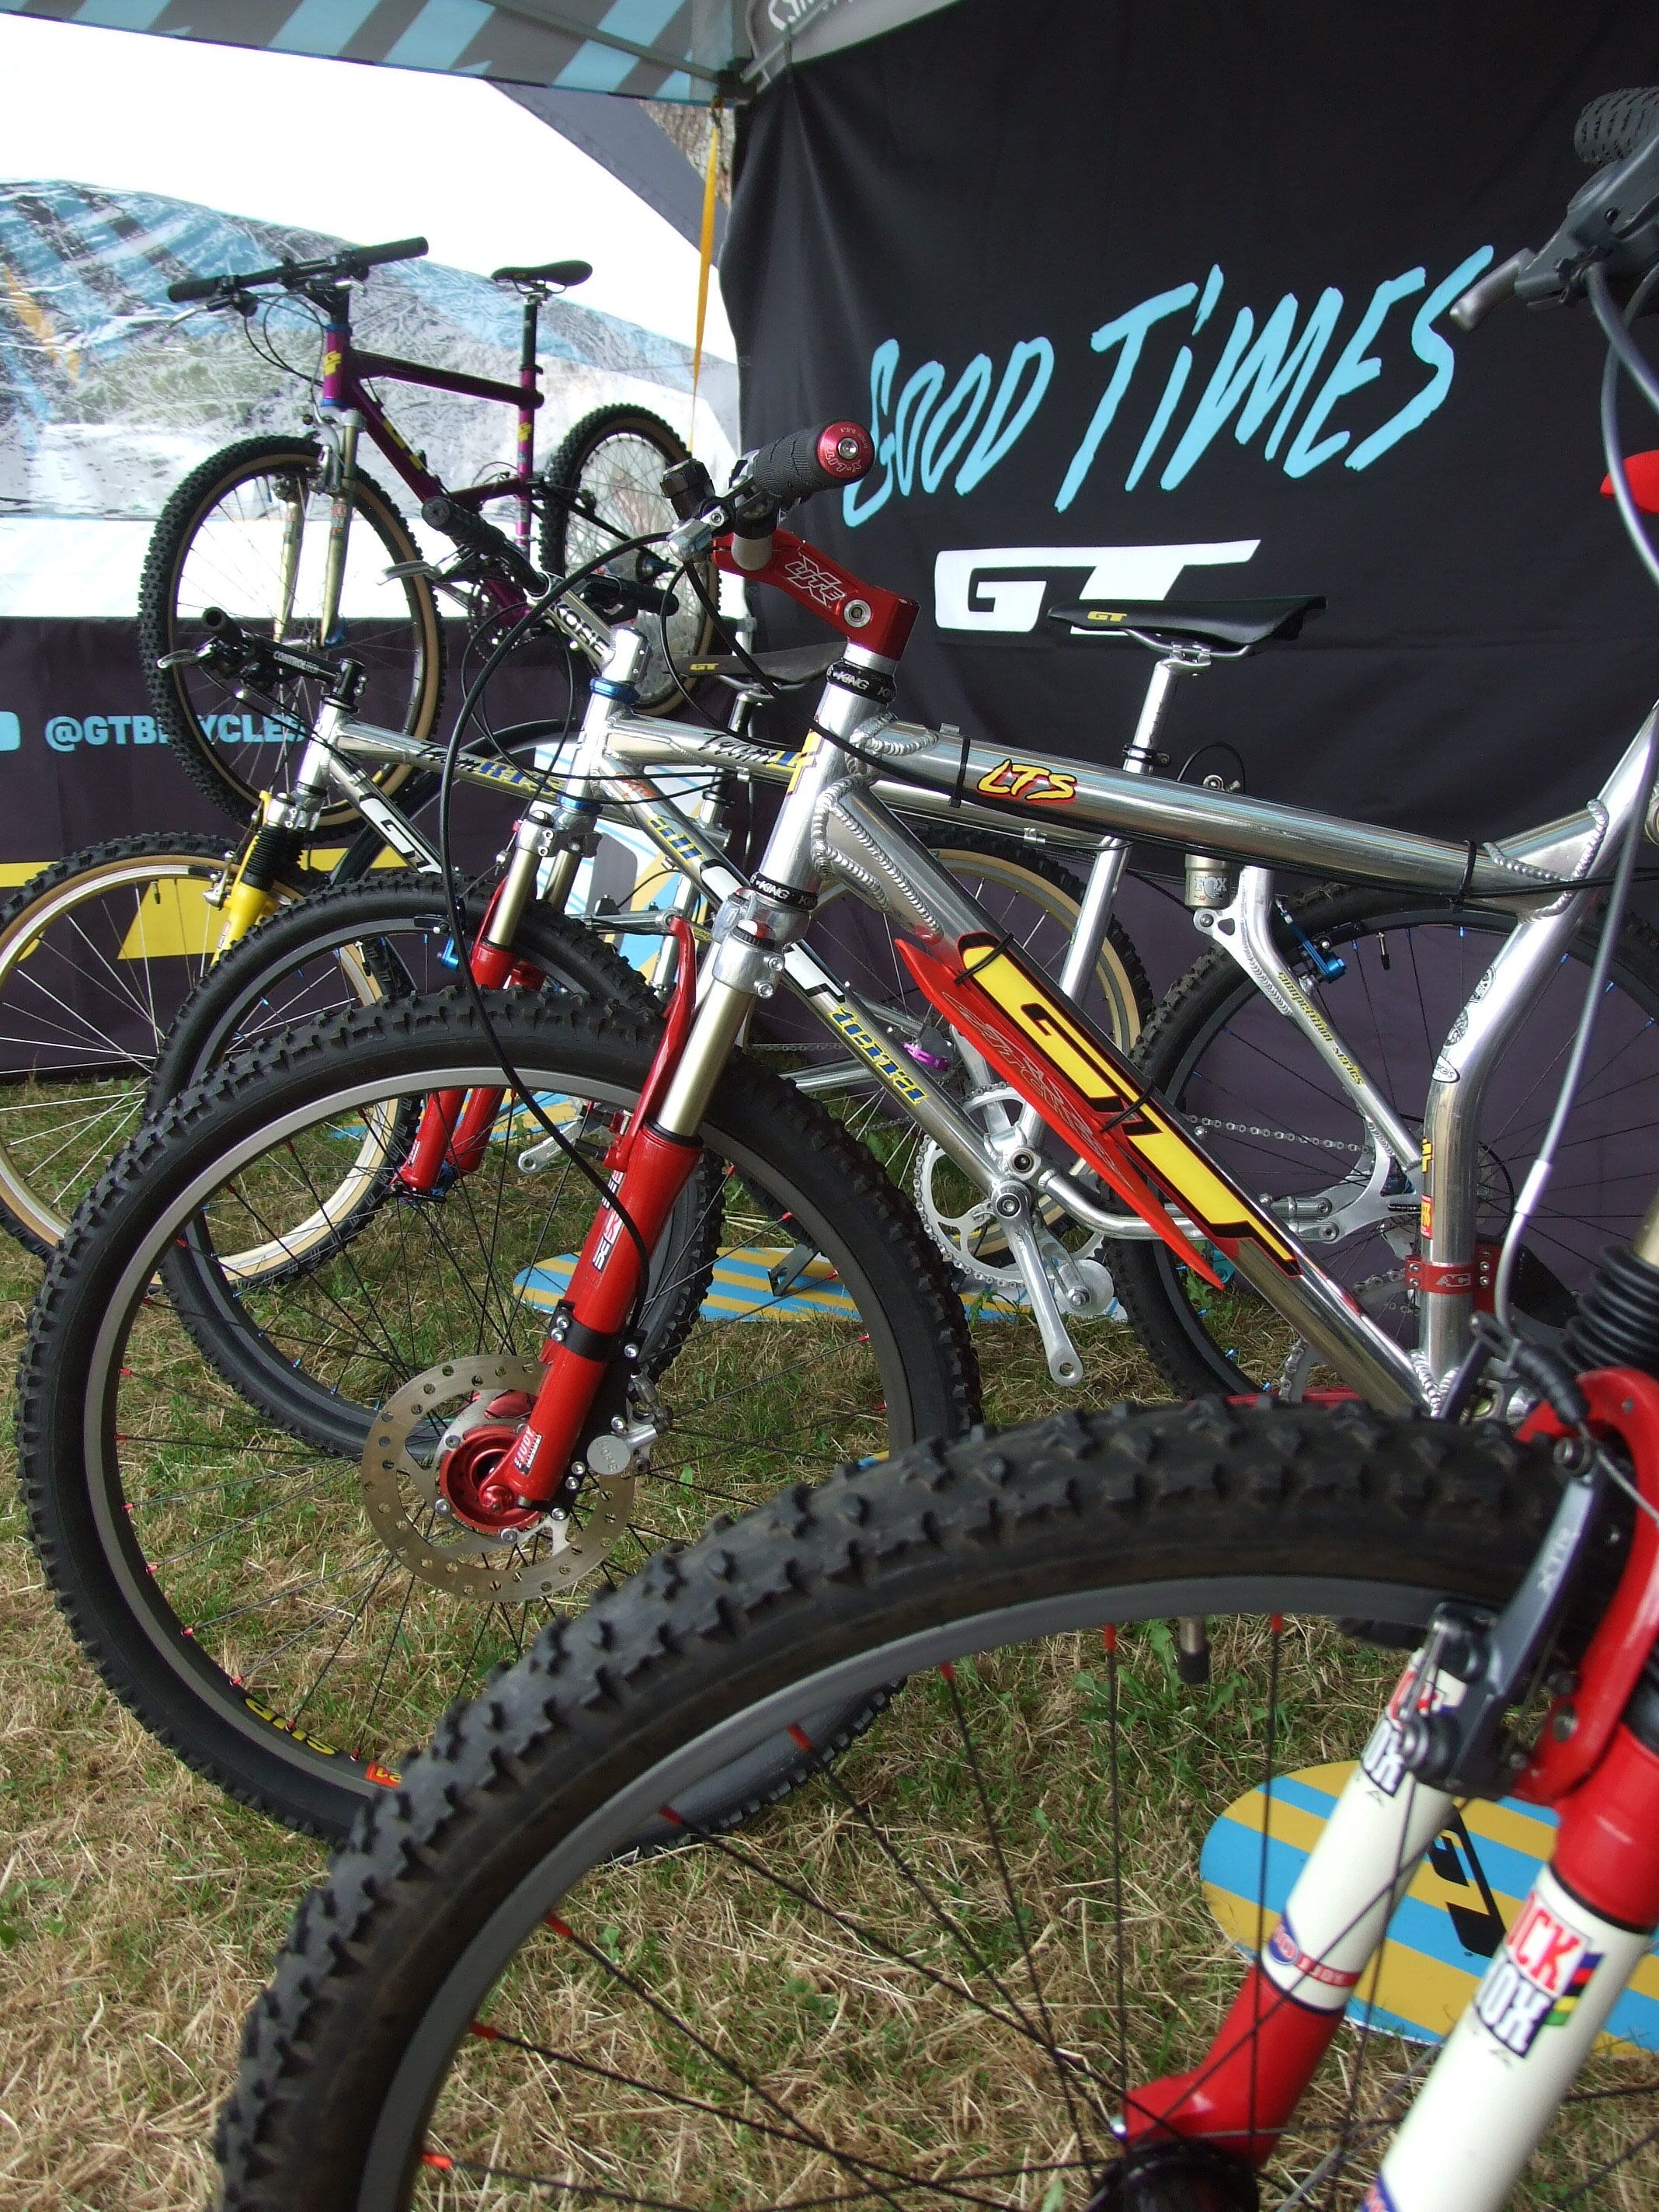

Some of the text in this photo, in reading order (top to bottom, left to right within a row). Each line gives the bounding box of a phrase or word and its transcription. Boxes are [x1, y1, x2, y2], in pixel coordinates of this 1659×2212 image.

[843, 337, 1055, 527] GOOD
[934, 539, 1261, 637] GT
[1087, 610, 1129, 623] GT
[837, 670, 871, 691] KING
[977, 758, 1079, 805] LTS
[760, 880, 791, 899] KING
[1195, 875, 1228, 899] FOX
[956, 931, 1303, 1278] GT
